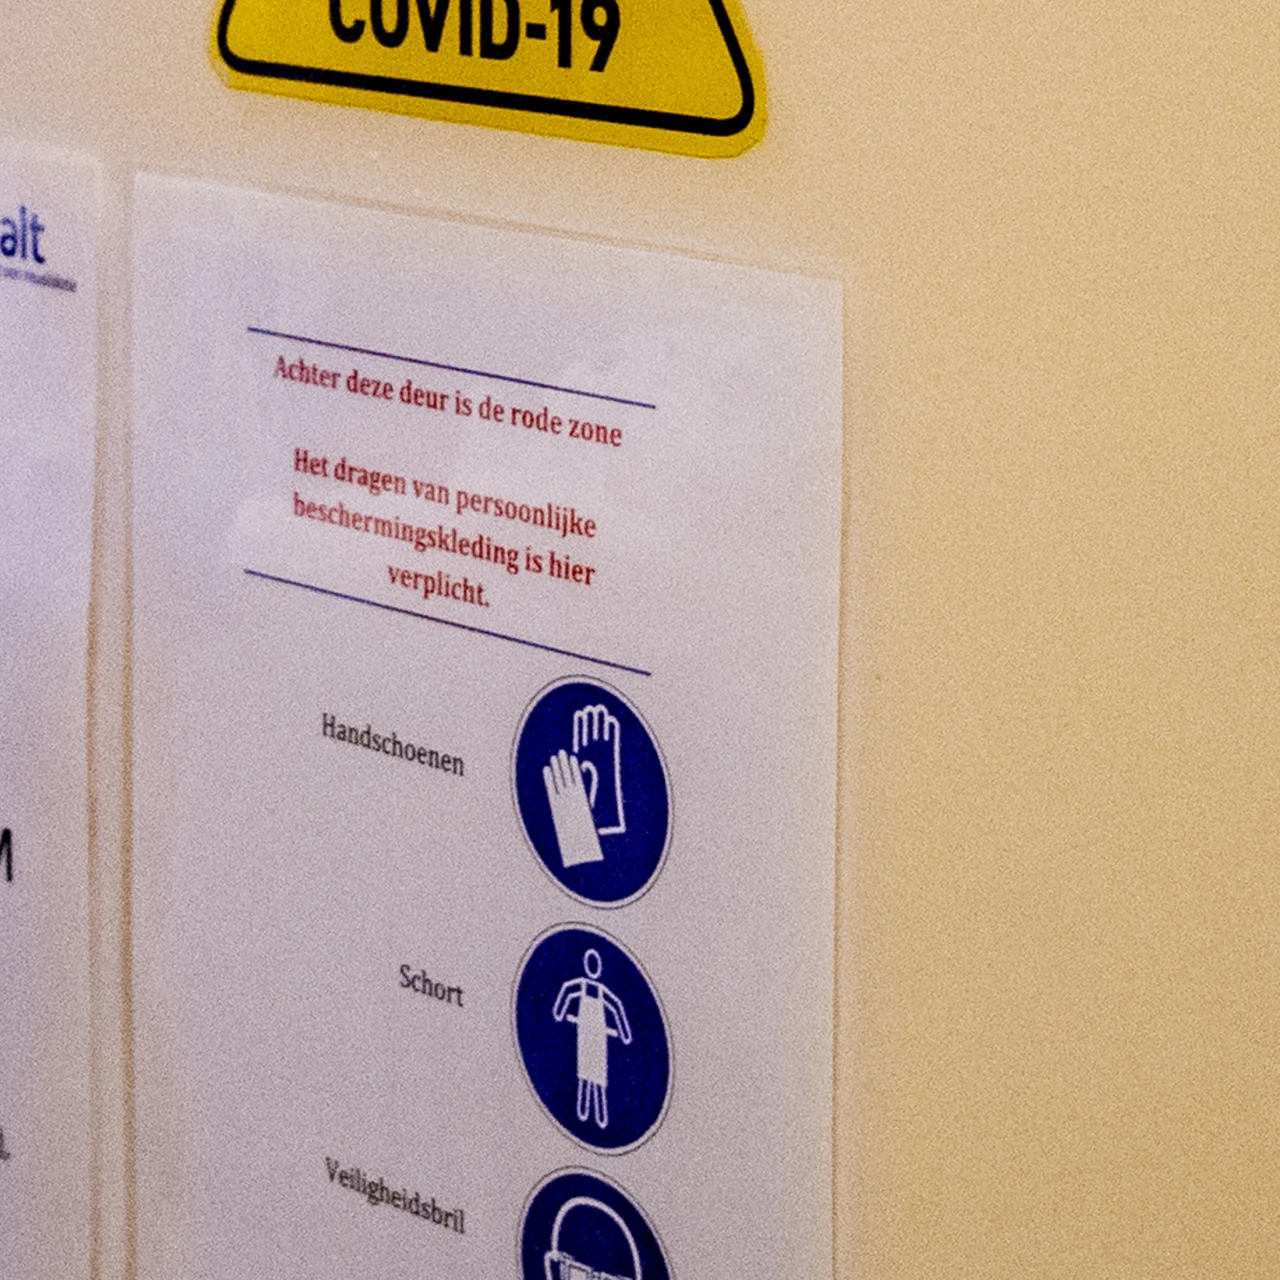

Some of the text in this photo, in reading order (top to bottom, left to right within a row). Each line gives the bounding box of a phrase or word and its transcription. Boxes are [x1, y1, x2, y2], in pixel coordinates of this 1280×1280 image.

[272, 354, 623, 448] Achter deze deur is de rode zone
[293, 447, 598, 539] Het dragen van persoonlijke
[293, 492, 597, 587] beschermingskleding is hier
[386, 563, 491, 609] verplicht.
[321, 712, 465, 777] Handschoenen
[399, 963, 465, 1008] Schort
[324, 1156, 466, 1235] Veiligheidsbril
